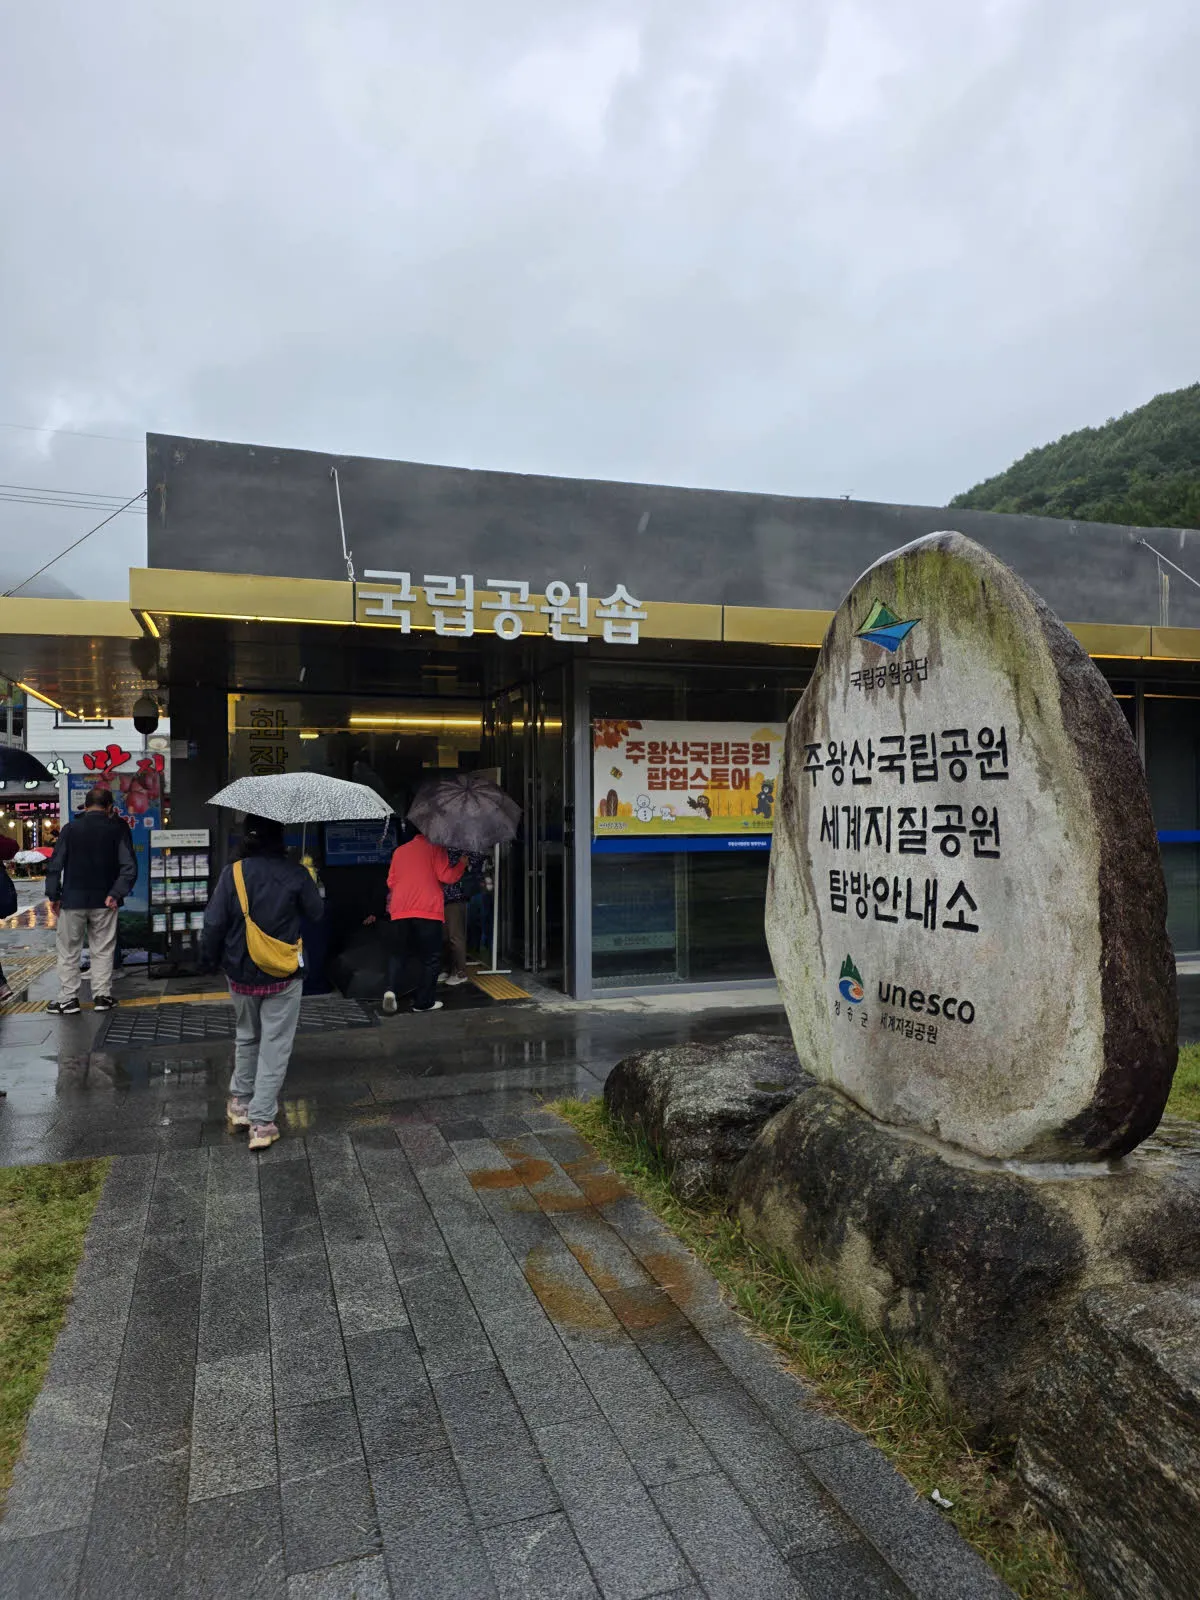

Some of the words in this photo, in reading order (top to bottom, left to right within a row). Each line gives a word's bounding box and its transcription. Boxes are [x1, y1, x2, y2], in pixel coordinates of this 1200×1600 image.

[358, 569, 648, 645] 국립공원숍
[850, 657, 929, 692] 국립공원공단
[625, 740, 771, 765] 주왕산국립공원
[803, 725, 1009, 788] 주왕산국립공원
[647, 767, 750, 791] 팝업스토어
[820, 804, 1001, 859] 세계지질공원
[829, 869, 980, 933] 탐방안내소
[878, 980, 976, 1025] unesco
[880, 1012, 938, 1045] 세계지질공원
